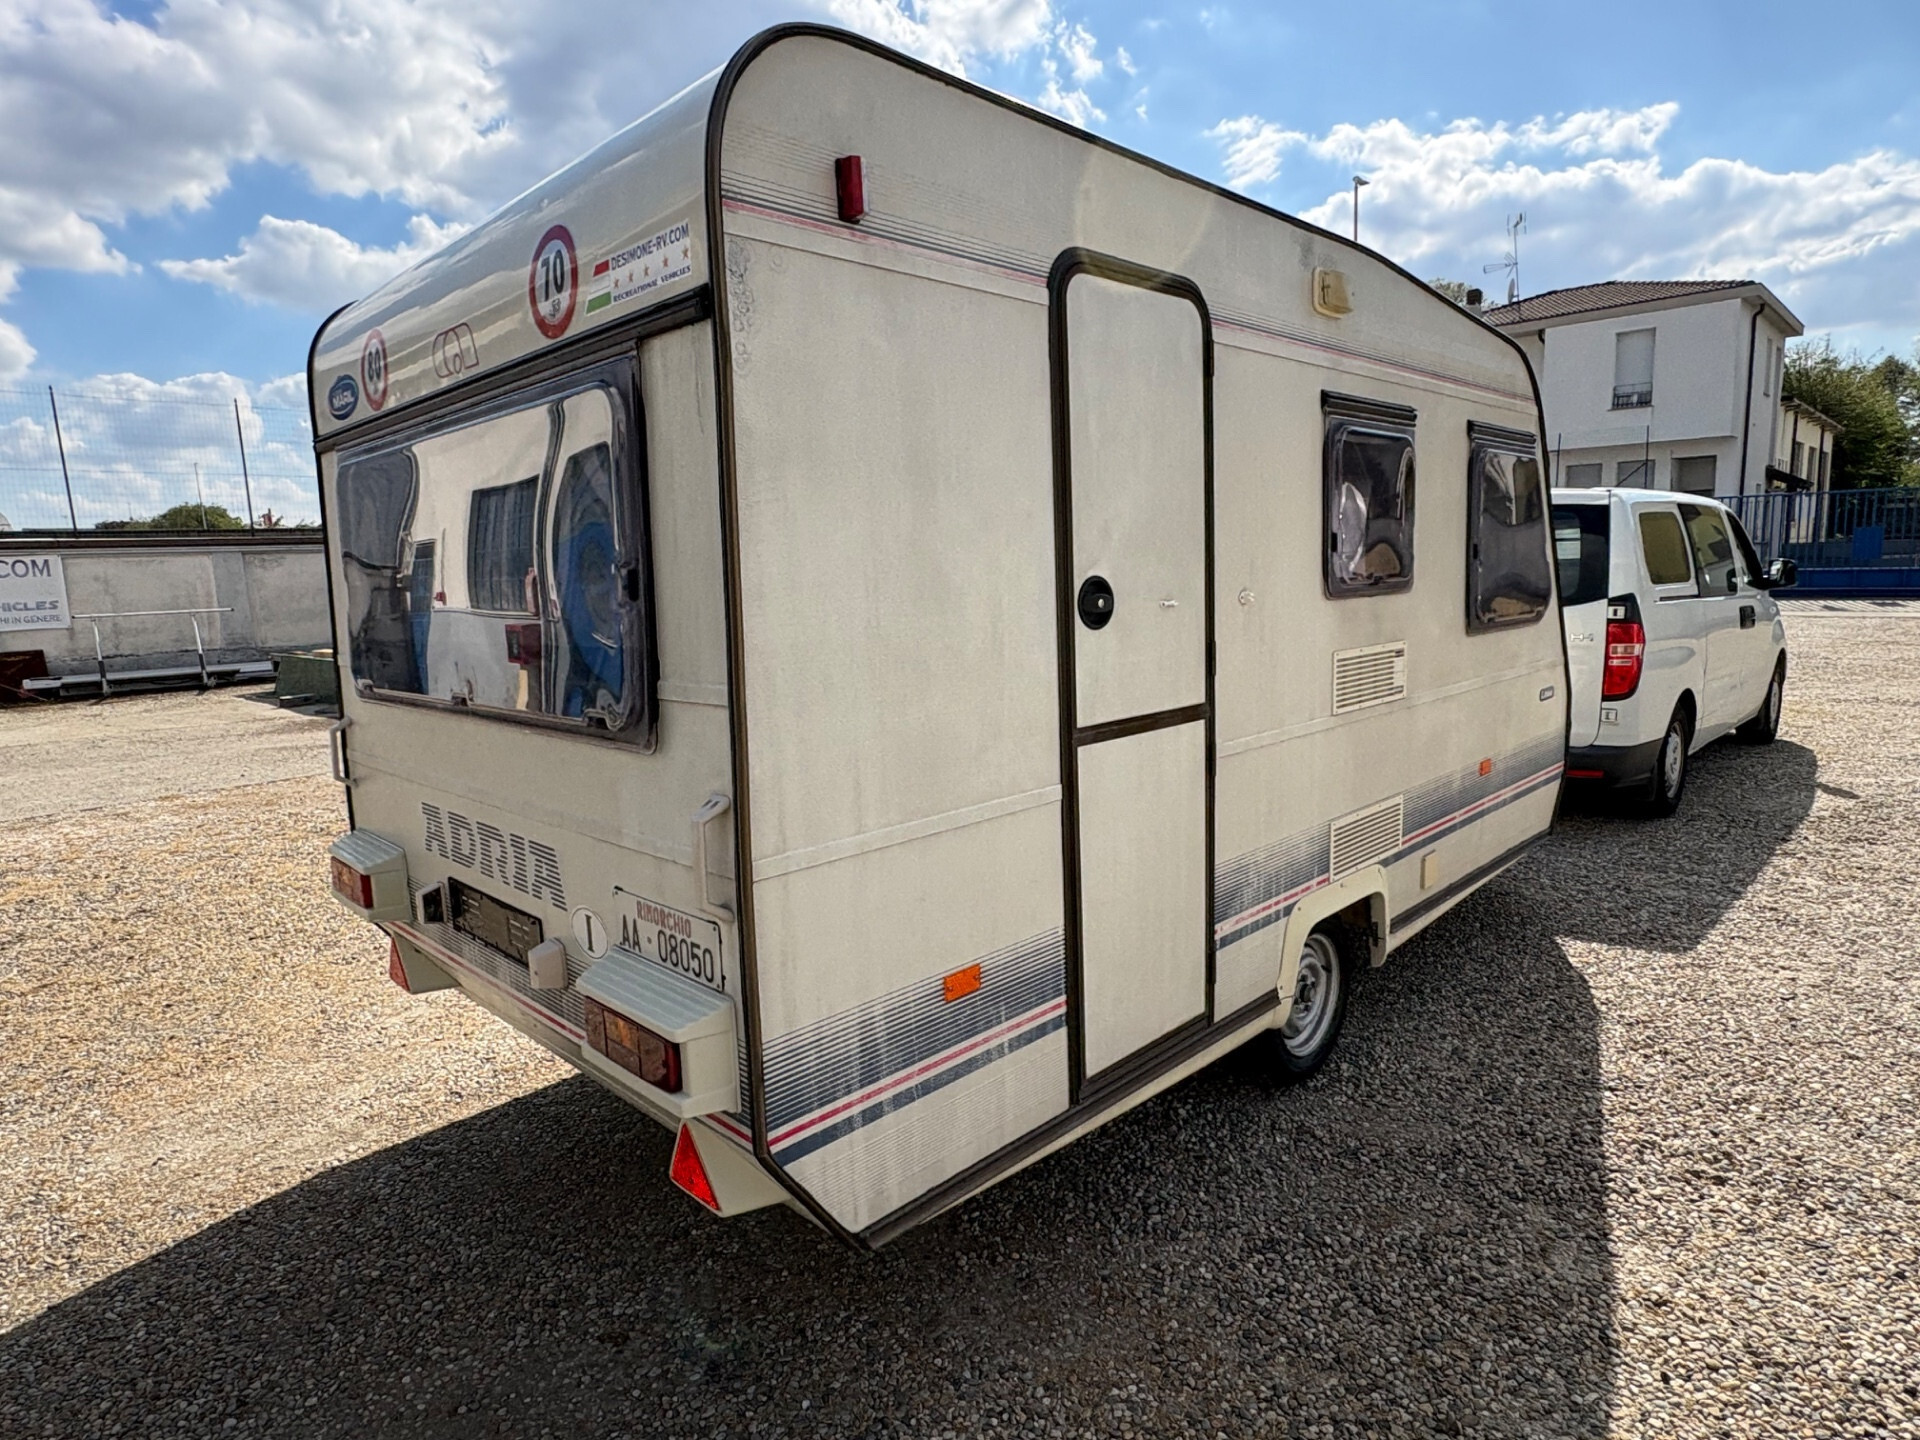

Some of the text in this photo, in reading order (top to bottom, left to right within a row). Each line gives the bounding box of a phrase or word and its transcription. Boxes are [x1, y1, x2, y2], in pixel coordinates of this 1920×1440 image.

[611, 223, 689, 271] DESIMONE-RV.COM
[541, 249, 565, 302] 70
[661, 265, 691, 283] VEHICLES
[368, 347, 382, 382] 80
[421, 802, 568, 912] ADRIA
[636, 900, 692, 939] RIMORCHIO
